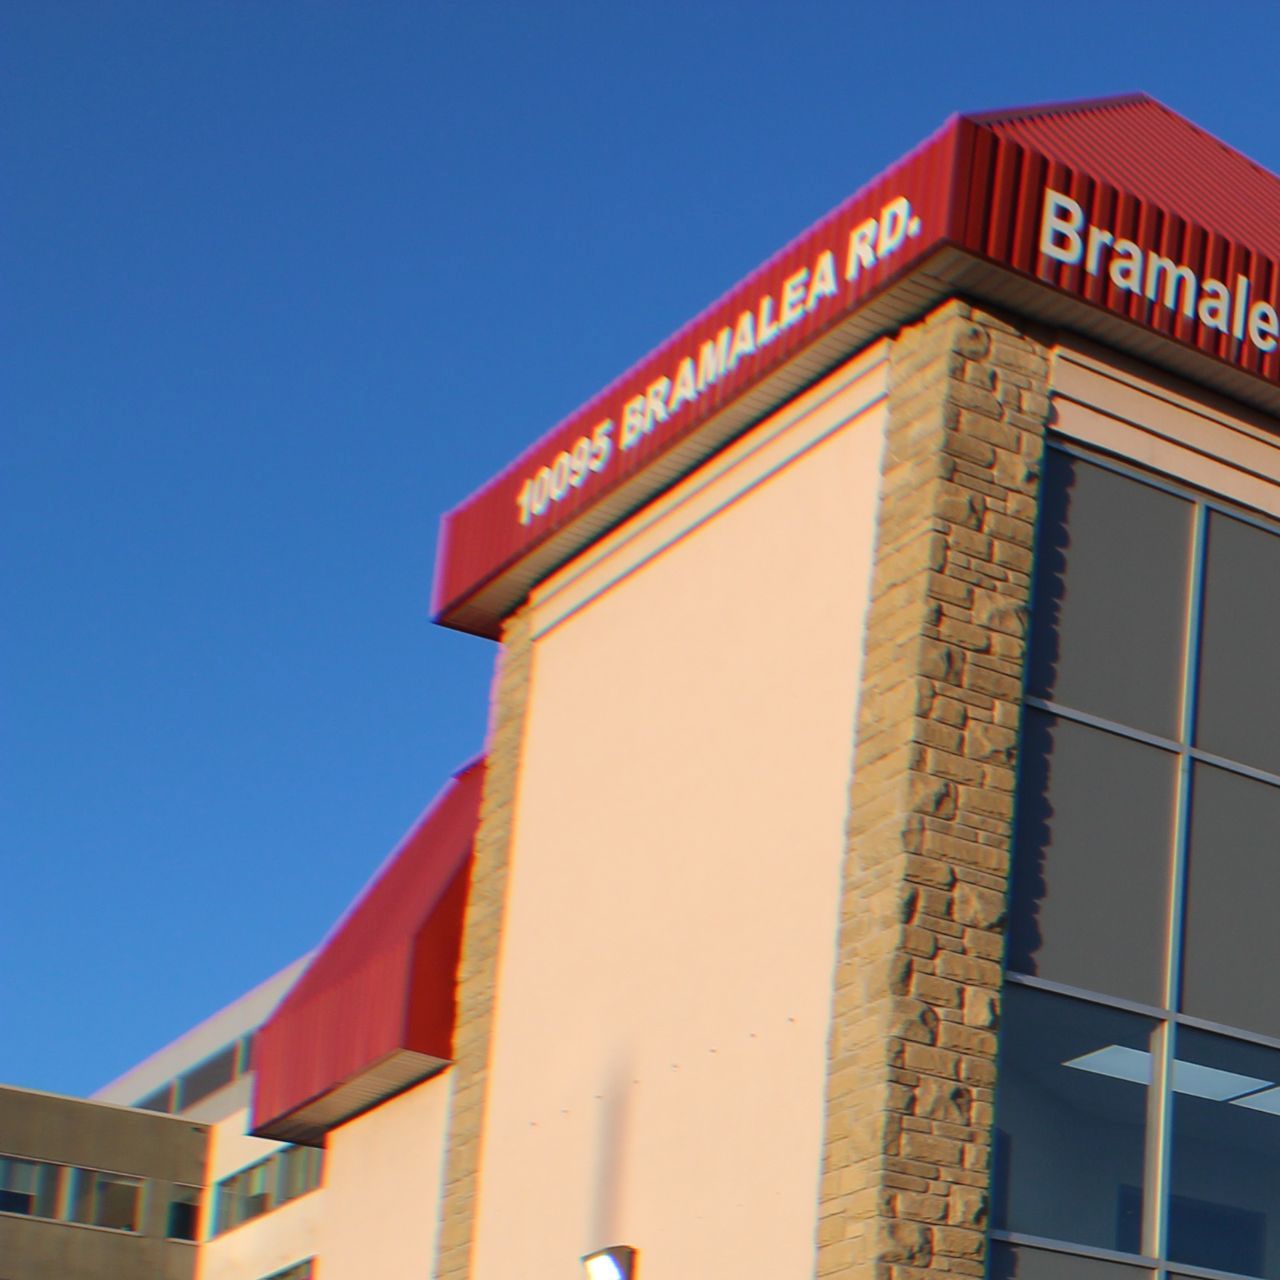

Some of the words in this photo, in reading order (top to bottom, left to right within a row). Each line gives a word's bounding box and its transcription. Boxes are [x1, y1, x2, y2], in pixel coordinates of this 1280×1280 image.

[516, 419, 615, 525] 10095
[619, 250, 838, 451] BRAMALEA
[845, 195, 921, 281] RD.
